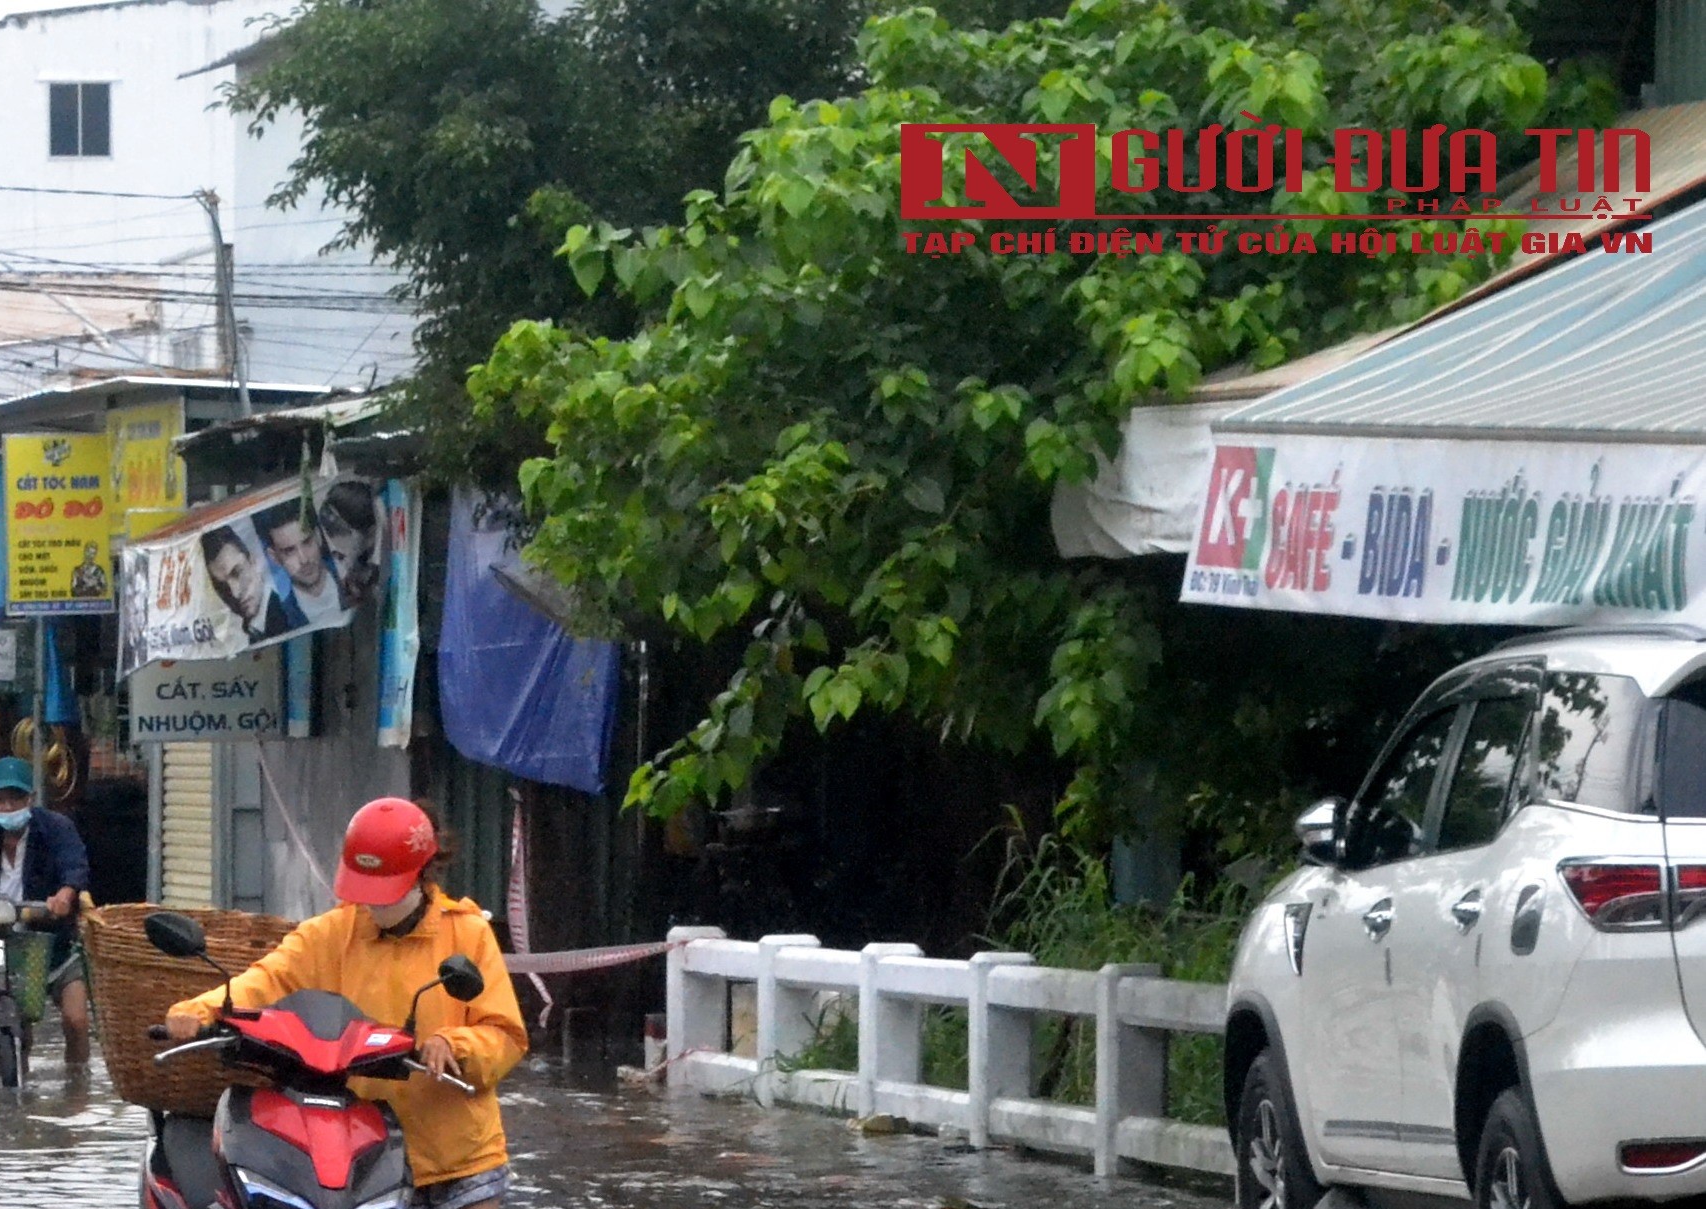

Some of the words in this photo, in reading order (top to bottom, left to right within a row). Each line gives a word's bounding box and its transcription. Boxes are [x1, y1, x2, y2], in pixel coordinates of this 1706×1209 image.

[1264, 461, 1343, 593] CAFÉ
[1357, 484, 1435, 598] BIDA
[1450, 466, 1540, 605] NƯỚC
[1530, 456, 1612, 605] GIẢI
[1592, 471, 1694, 612] KHÁT
[156, 675, 206, 701] CẮT,
[212, 674, 260, 699] SẤY
